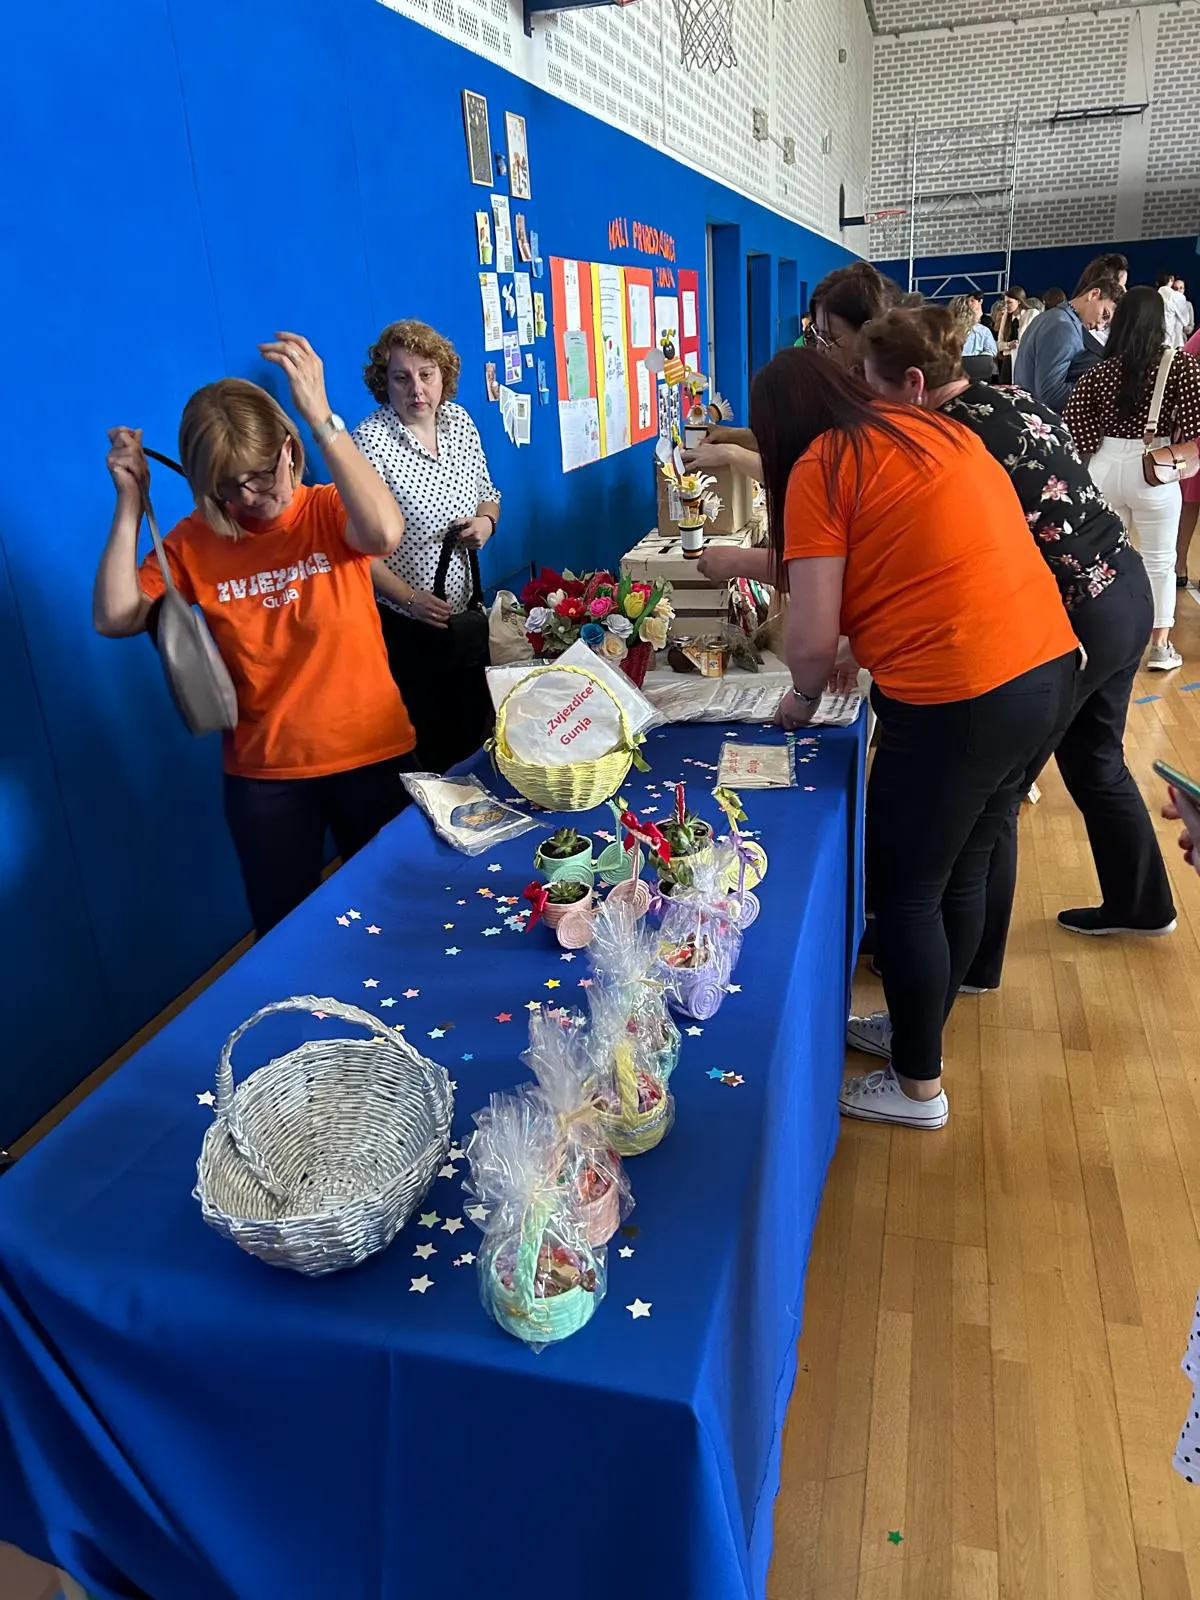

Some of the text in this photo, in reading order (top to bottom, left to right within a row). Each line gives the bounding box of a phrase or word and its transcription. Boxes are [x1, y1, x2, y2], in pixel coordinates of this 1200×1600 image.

[608, 217, 629, 251] MALI
[216, 552, 332, 602] ZVJEZDICE
[559, 716, 592, 746] Gunja
